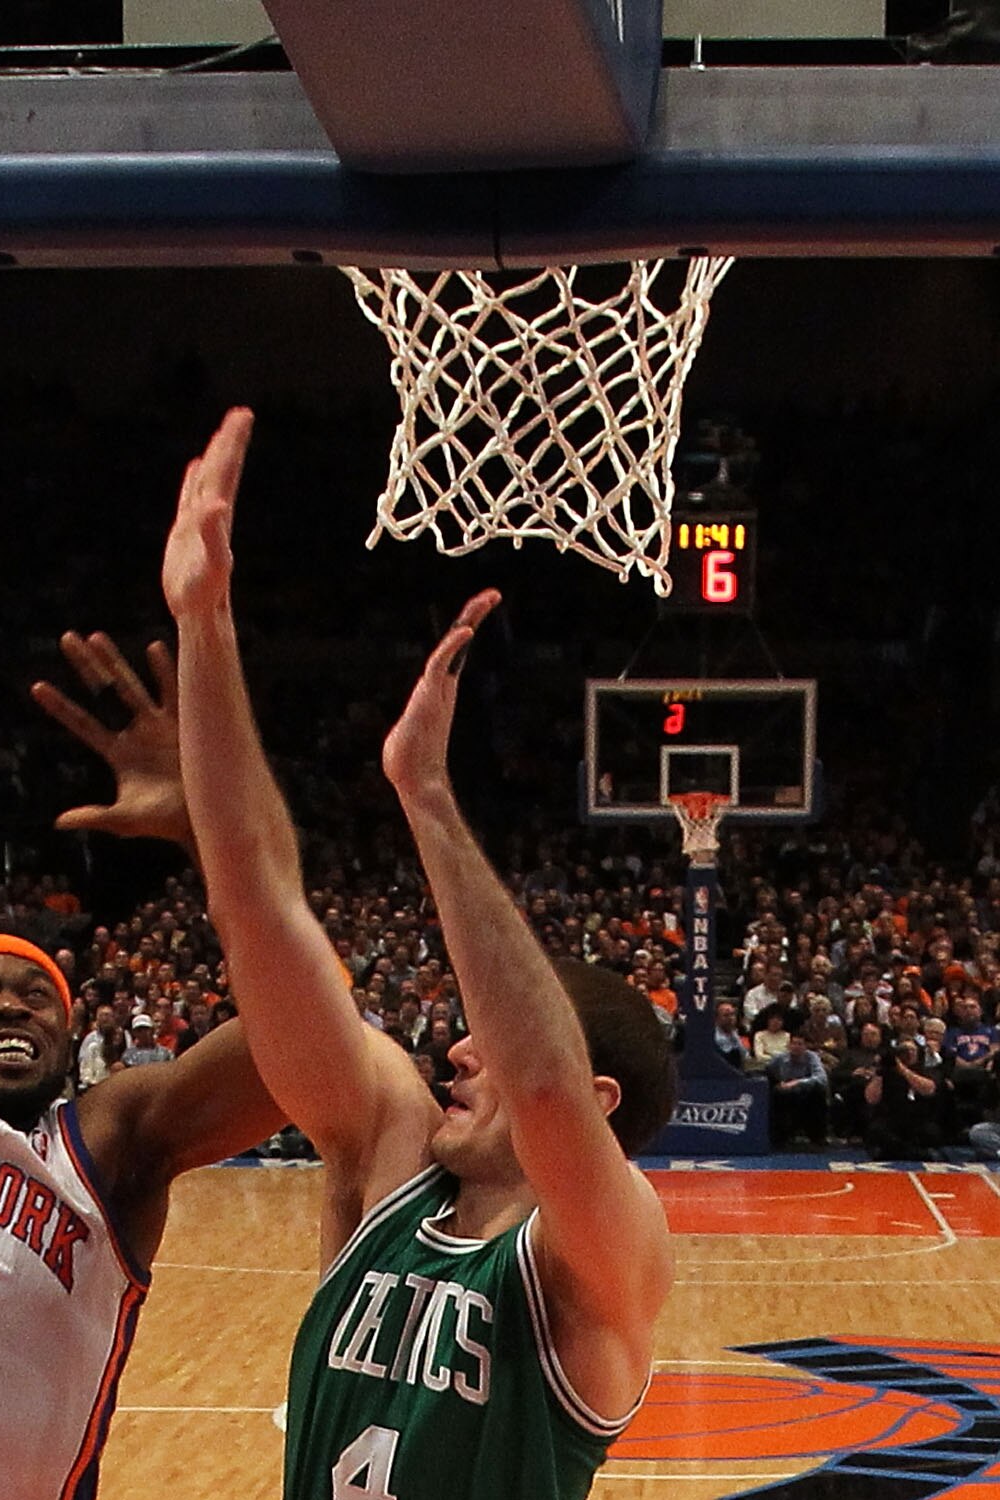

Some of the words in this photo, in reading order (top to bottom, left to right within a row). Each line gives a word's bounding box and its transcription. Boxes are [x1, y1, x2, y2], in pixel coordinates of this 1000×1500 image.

[678, 523, 746, 550] 11:41
[702, 550, 737, 602] 6
[693, 917, 709, 970] NBA
[693, 977, 708, 1011] TV
[670, 1105, 749, 1123] LAYOFFS
[327, 1269, 495, 1406] CELTICS
